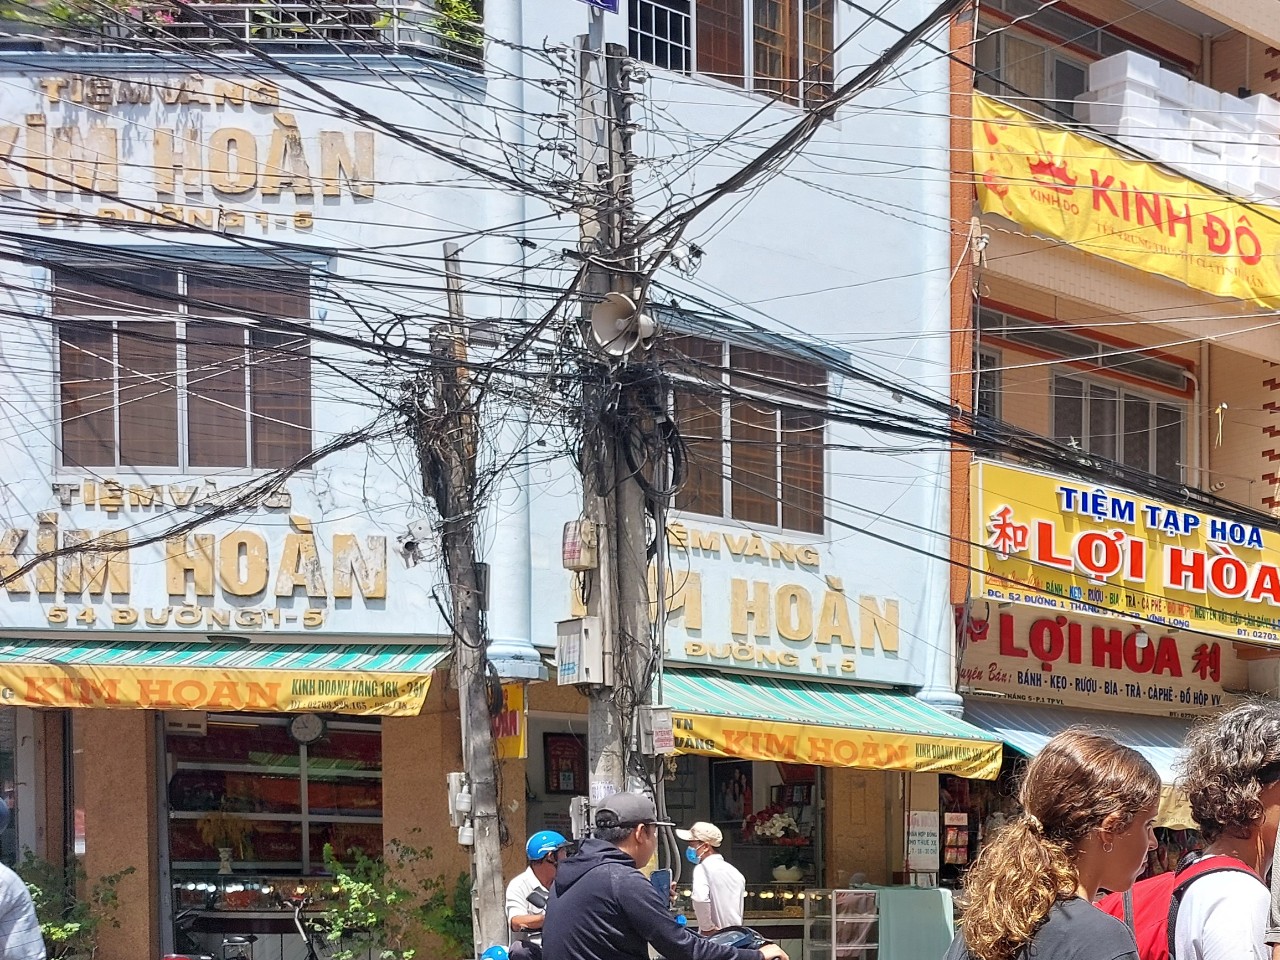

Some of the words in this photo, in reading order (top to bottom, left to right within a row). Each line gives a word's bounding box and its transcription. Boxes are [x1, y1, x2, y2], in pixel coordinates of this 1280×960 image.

[40, 75, 152, 111] TIỆM
[153, 112, 375, 196] HOÀN
[1090, 168, 1193, 244] KINH
[1203, 212, 1262, 266] ĐÔ
[52, 478, 164, 513] TIỆM
[1058, 485, 1136, 522] TIỆM
[1142, 503, 1201, 537] TẠP
[165, 514, 387, 600] HOÀN
[722, 533, 820, 567] VÀNG
[1034, 519, 1146, 585] LỢI
[47, 606, 97, 624] 54
[111, 600, 263, 626] ĐƯỜNG
[731, 574, 899, 652] HOÀN
[1008, 592, 1021, 602] 52
[1024, 594, 1057, 607] ĐƯỜNG
[1168, 616, 1190, 629] LONG
[685, 640, 799, 667] ĐƯỜNG
[999, 613, 1082, 673] LỢI
[24, 675, 121, 705] KIM
[138, 671, 282, 709] HOÀN
[291, 679, 316, 696] KINH
[318, 679, 349, 697] DOANH
[351, 676, 378, 698] VÀNG
[959, 667, 984, 687] uyên
[1017, 667, 1043, 687] BÁNH
[1049, 674, 1067, 692] KẸO
[1075, 675, 1098, 699] RƯỢU
[1125, 678, 1142, 699] TRÀ
[1180, 687, 1191, 705] ĐỒ
[1193, 688, 1208, 706] HỘP
[722, 729, 797, 760] KIM
[807, 734, 909, 770] HOÀN
